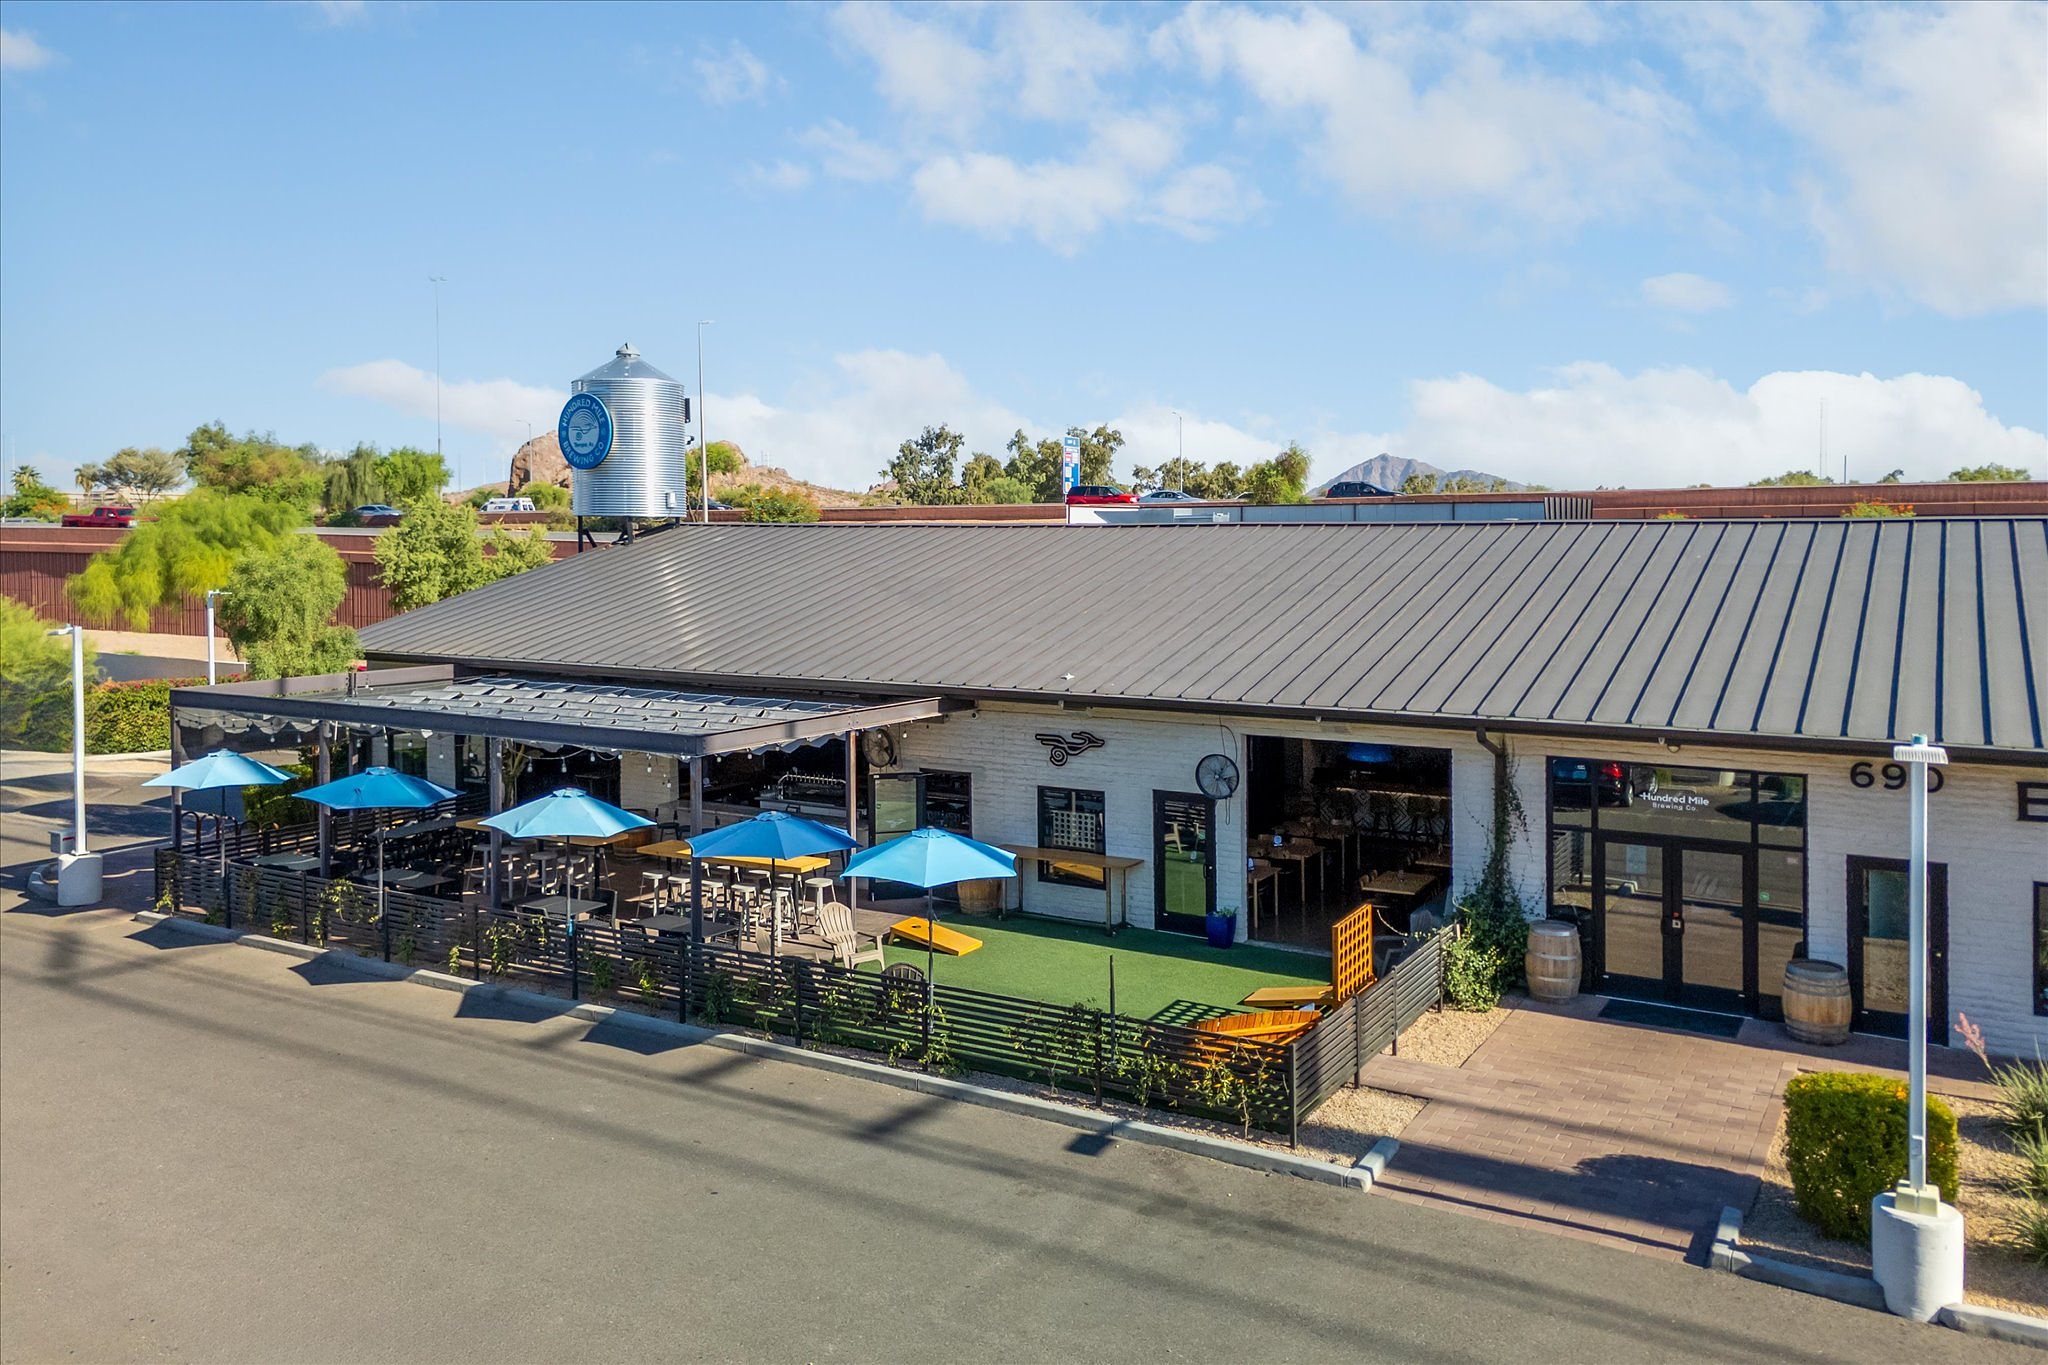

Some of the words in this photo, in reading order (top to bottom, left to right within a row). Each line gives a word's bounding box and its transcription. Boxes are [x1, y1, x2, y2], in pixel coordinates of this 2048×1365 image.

[562, 398, 591, 427] HUNDRED
[591, 402, 606, 424] MILE
[562, 440, 595, 465] BREWING
[594, 441, 604, 456] CO
[1640, 792, 1686, 804] Hundred
[1688, 796, 1709, 806] Mile
[1652, 802, 1683, 811] Brewing
